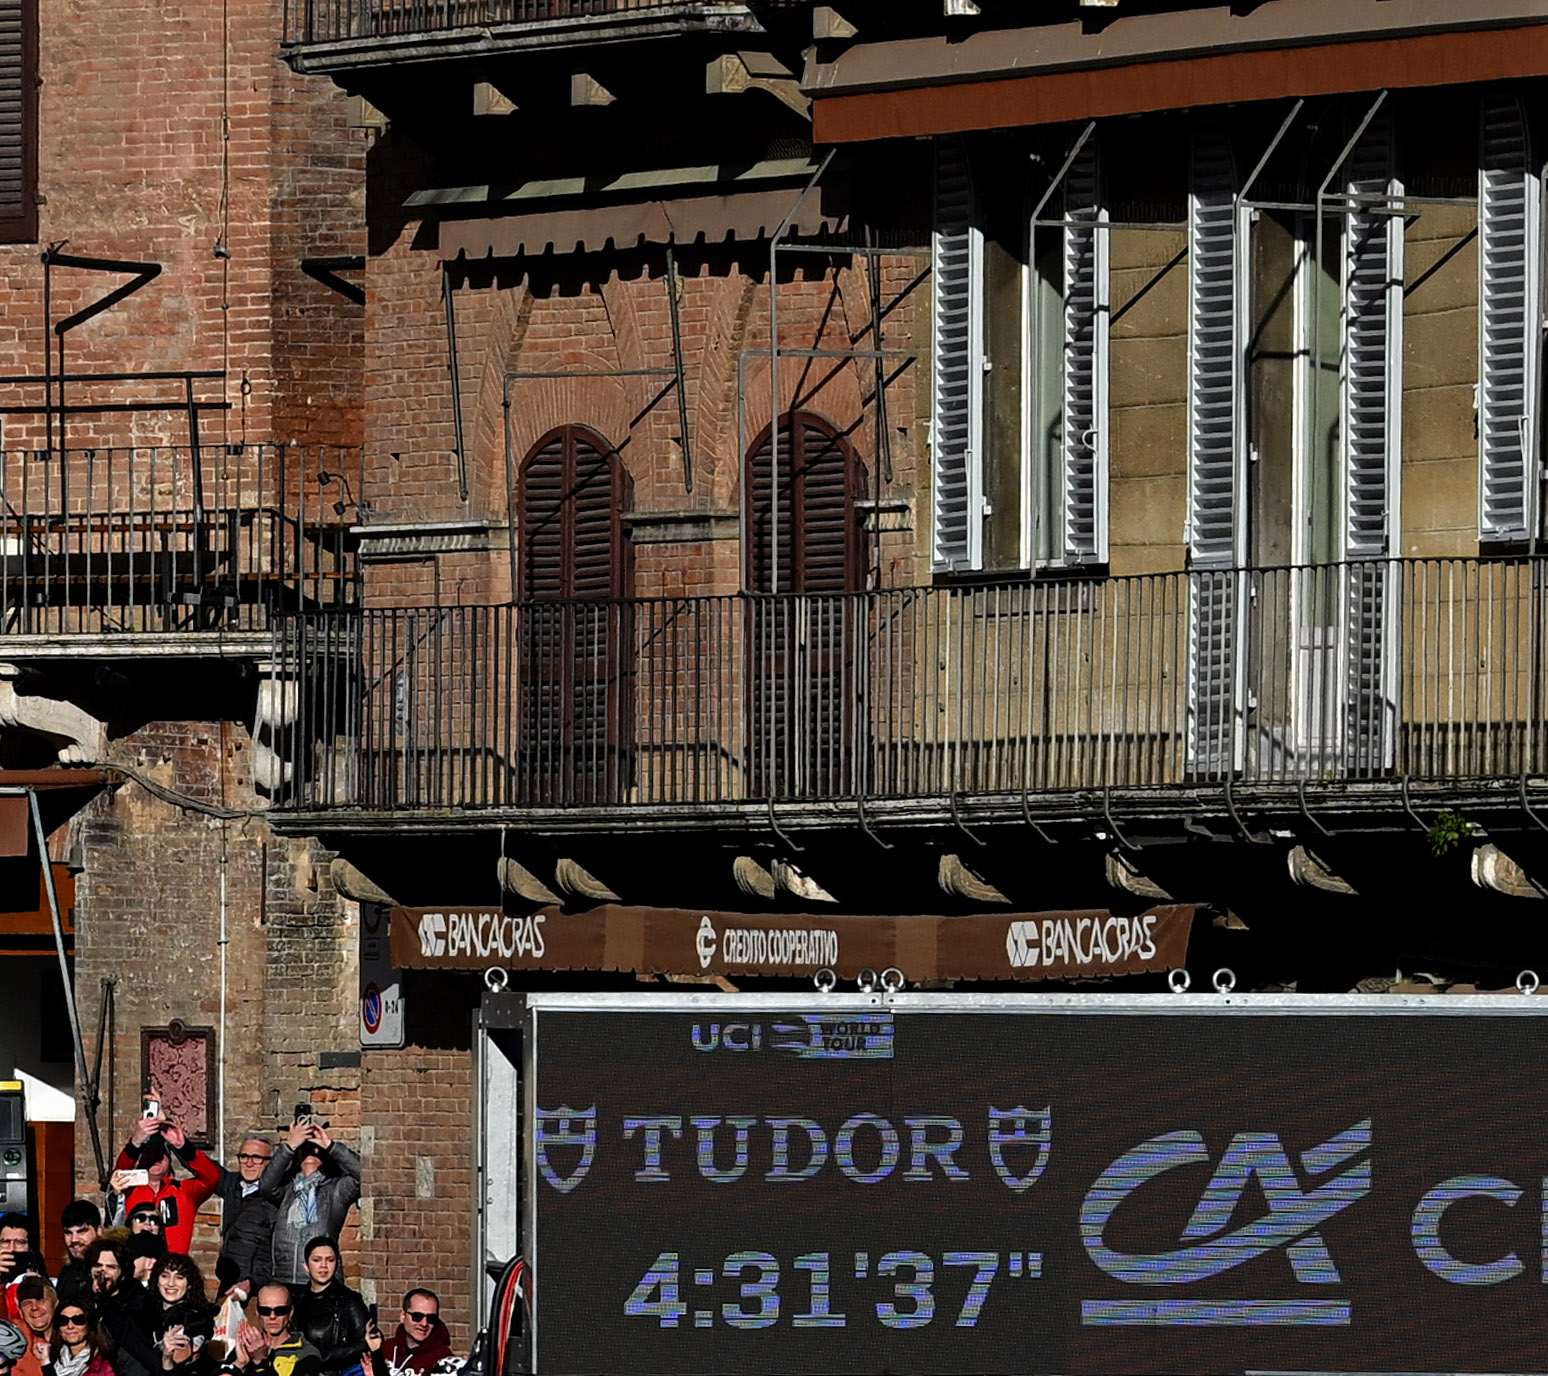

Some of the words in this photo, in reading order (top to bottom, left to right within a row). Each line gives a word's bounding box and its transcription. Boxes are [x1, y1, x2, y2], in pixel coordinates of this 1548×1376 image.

[722, 928, 767, 964] CREDITO
[768, 929, 838, 965] COOPERATIVO
[691, 1023, 762, 1052] UCI
[622, 1113, 970, 1184] TUDOR
